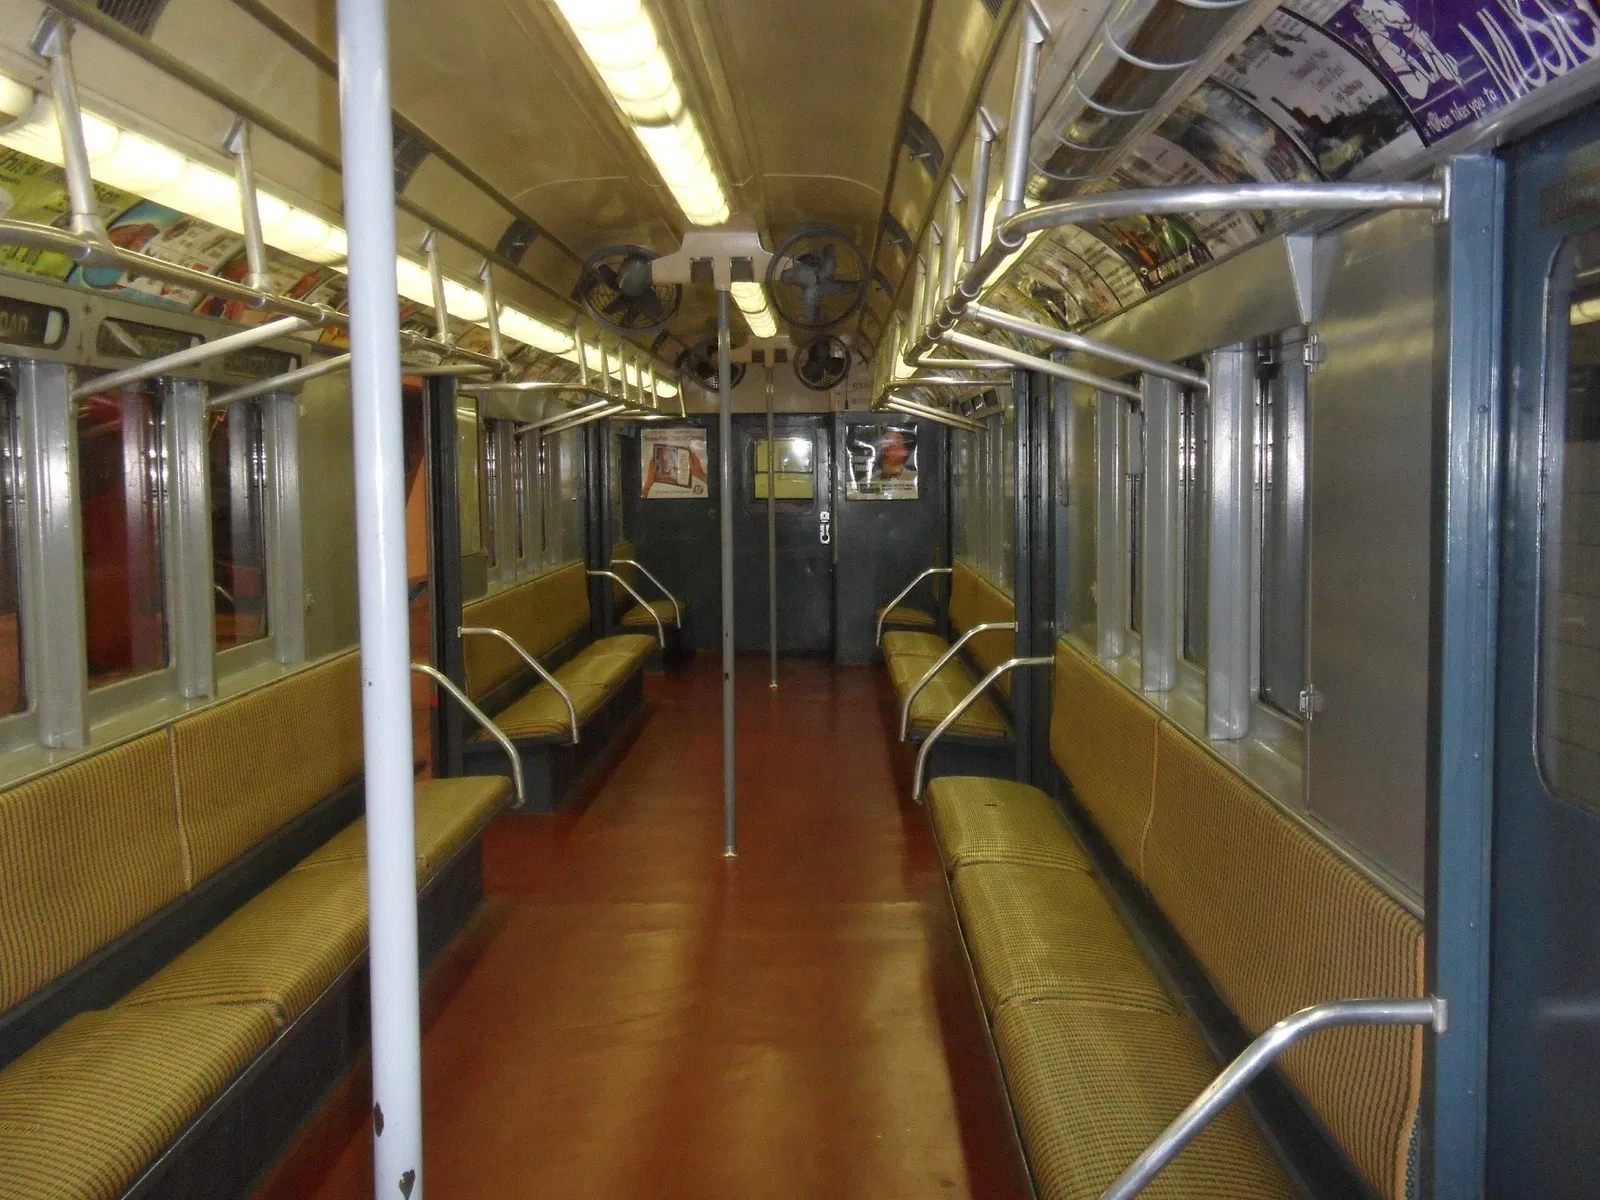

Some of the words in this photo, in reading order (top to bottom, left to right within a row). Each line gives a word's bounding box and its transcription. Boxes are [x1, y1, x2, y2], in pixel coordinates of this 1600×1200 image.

[1450, 101, 1471, 123] takes
[1467, 96, 1486, 119] you
[1483, 87, 1498, 101] to
